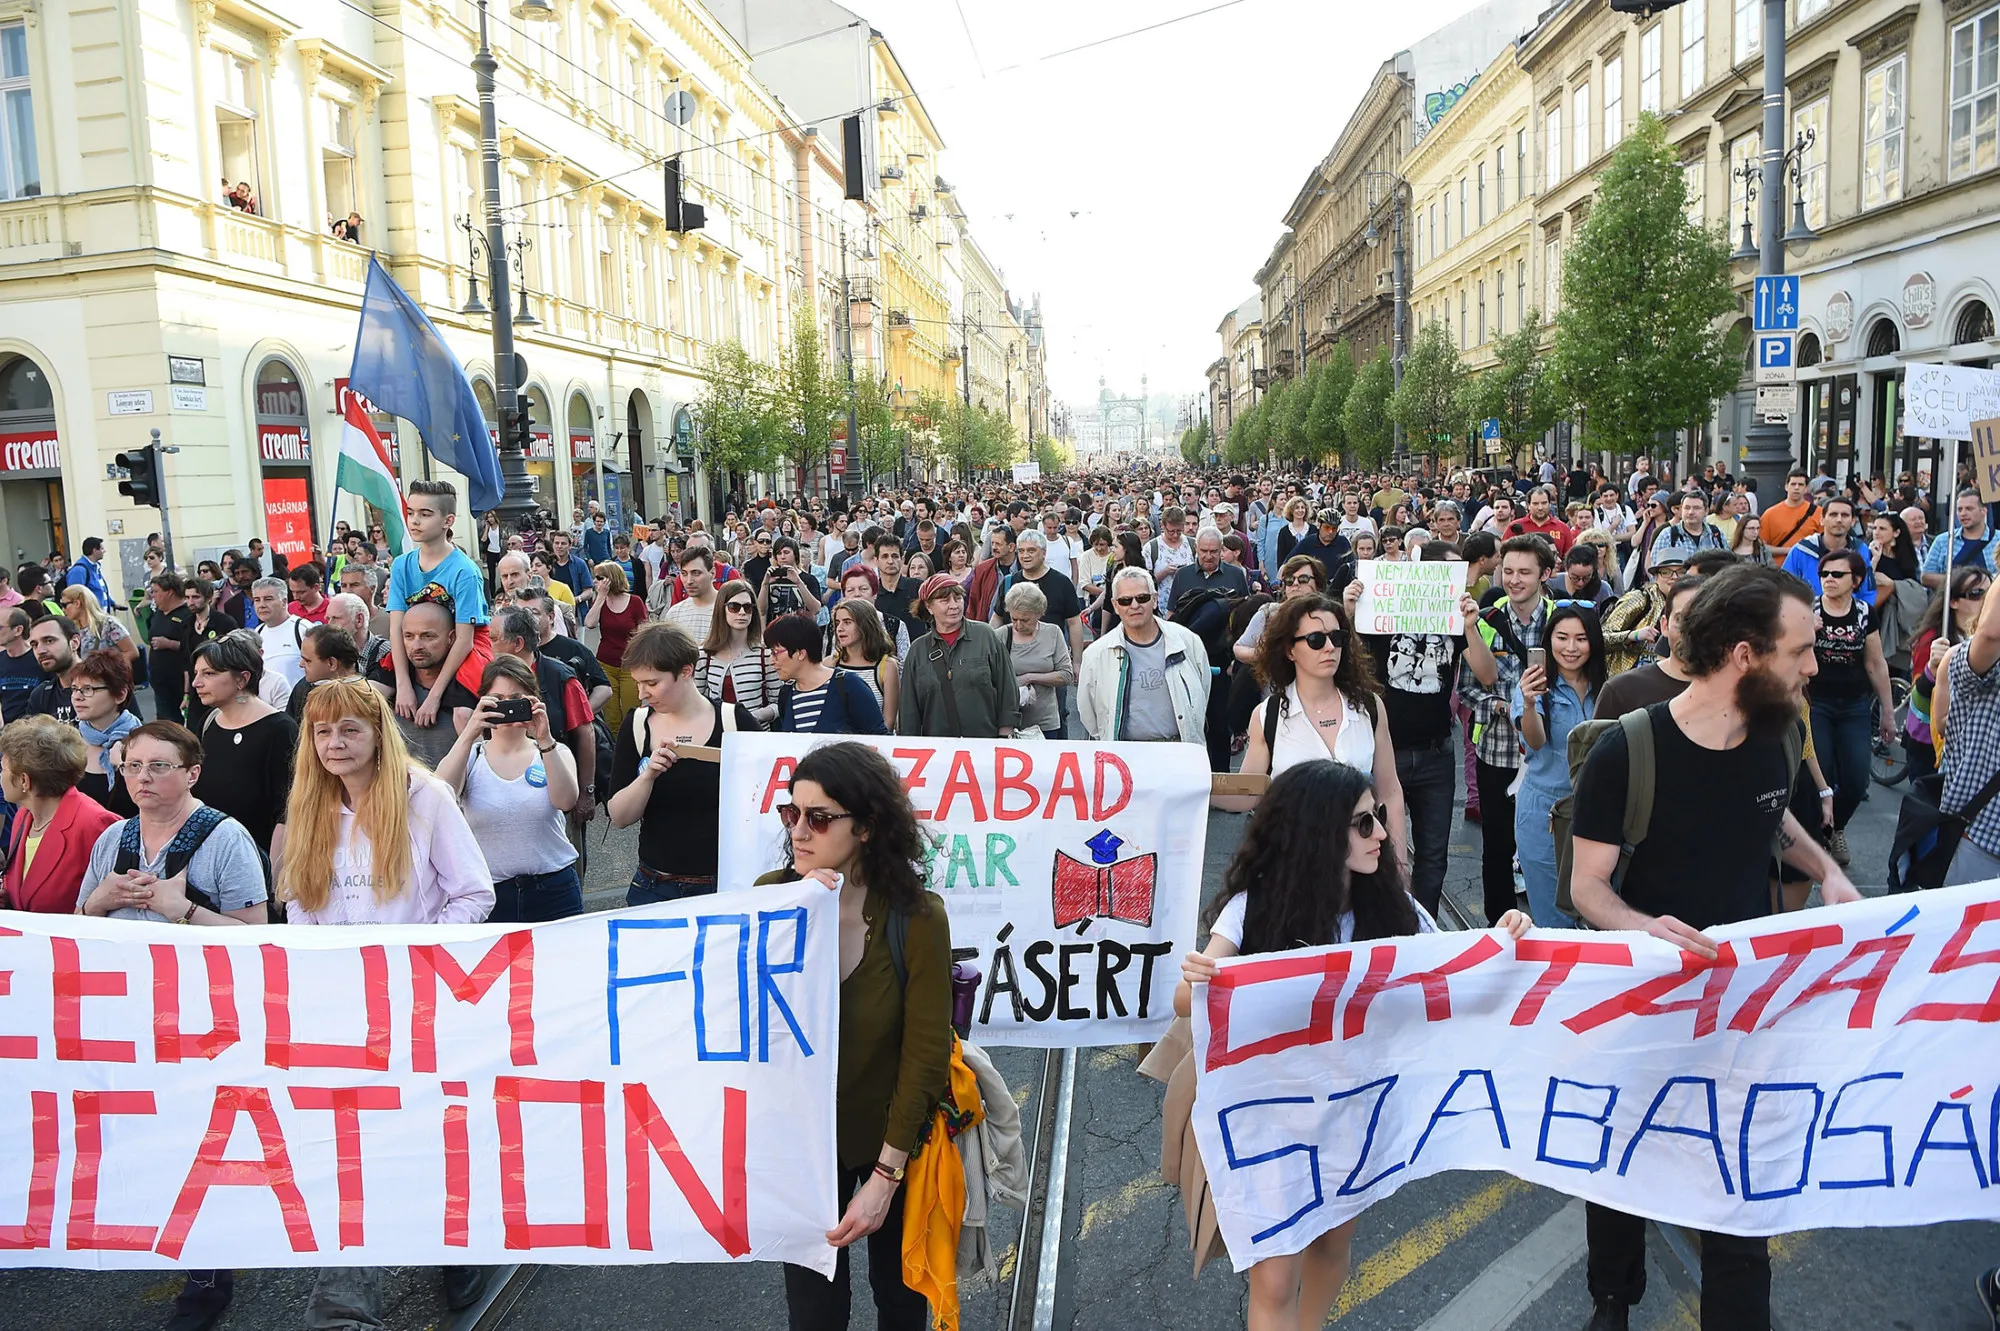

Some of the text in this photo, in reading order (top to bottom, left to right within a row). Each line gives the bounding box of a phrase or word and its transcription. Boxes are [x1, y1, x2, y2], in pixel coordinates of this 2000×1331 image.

[1766, 341, 1785, 364] P
[1924, 389, 1969, 412] CEU
[1984, 399, 1998, 409] THE
[5, 439, 61, 470] cream
[263, 431, 301, 460] cream
[266, 499, 308, 515] VASÁRNAP
[286, 522, 293, 534] IS
[277, 540, 307, 554] NYITVA
[1375, 564, 1453, 582] NEM AKARUNK
[1373, 598, 1394, 613] WE
[1428, 599, 1455, 613] WANT
[1374, 615, 1454, 633] CEUTHANASIA!
[869, 746, 1134, 822] ZABAD
[608, 906, 815, 1066] FOR
[1216, 1068, 2000, 1245] SZABADSÁ
